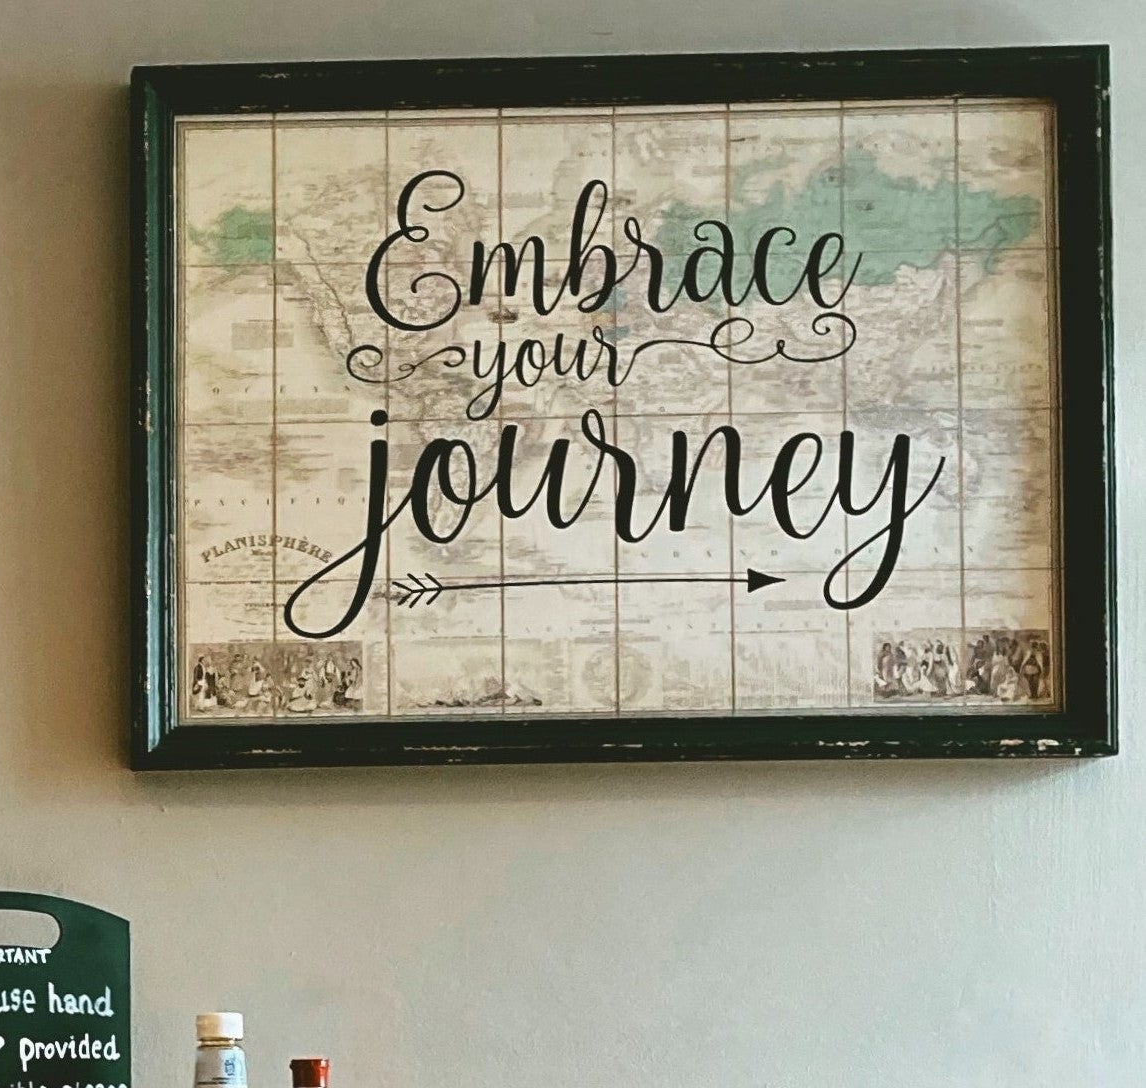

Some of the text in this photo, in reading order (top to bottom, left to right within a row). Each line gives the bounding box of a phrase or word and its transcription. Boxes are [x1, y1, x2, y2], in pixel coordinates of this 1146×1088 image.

[365, 170, 862, 332] Embrace
[466, 326, 642, 421] your
[284, 408, 946, 639] journey
[47, 981, 114, 1017] hand
[19, 1033, 121, 1072] provided
